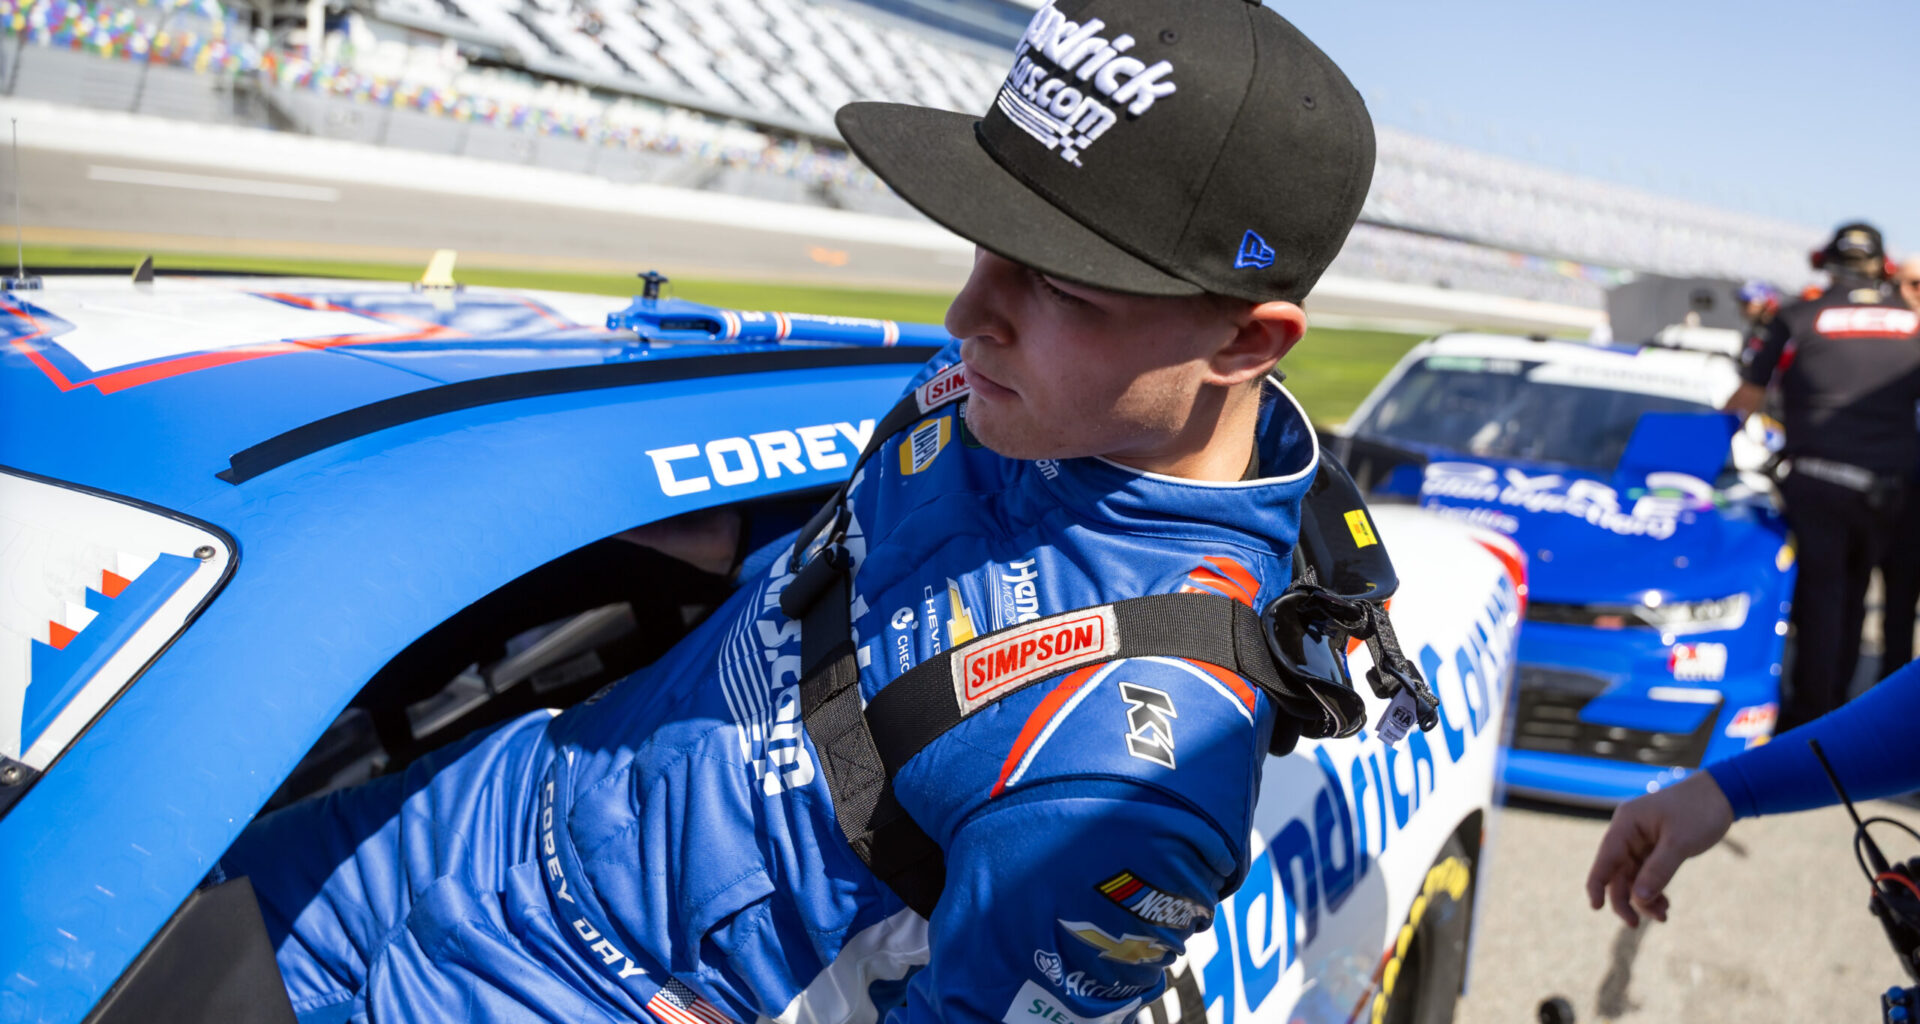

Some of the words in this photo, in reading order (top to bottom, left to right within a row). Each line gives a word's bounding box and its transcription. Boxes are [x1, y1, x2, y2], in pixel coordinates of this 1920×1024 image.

[932, 371, 966, 399] SIM
[646, 418, 876, 497] COREY
[913, 422, 939, 470] NAPA
[971, 625, 1095, 689] SIMPSON
[1118, 681, 1177, 770] K1
[1392, 707, 1412, 727] FIA
[542, 780, 575, 905] COREY
[572, 916, 650, 980] DAY
[1066, 971, 1147, 998] Atrium
[1028, 998, 1075, 1024] SIE
